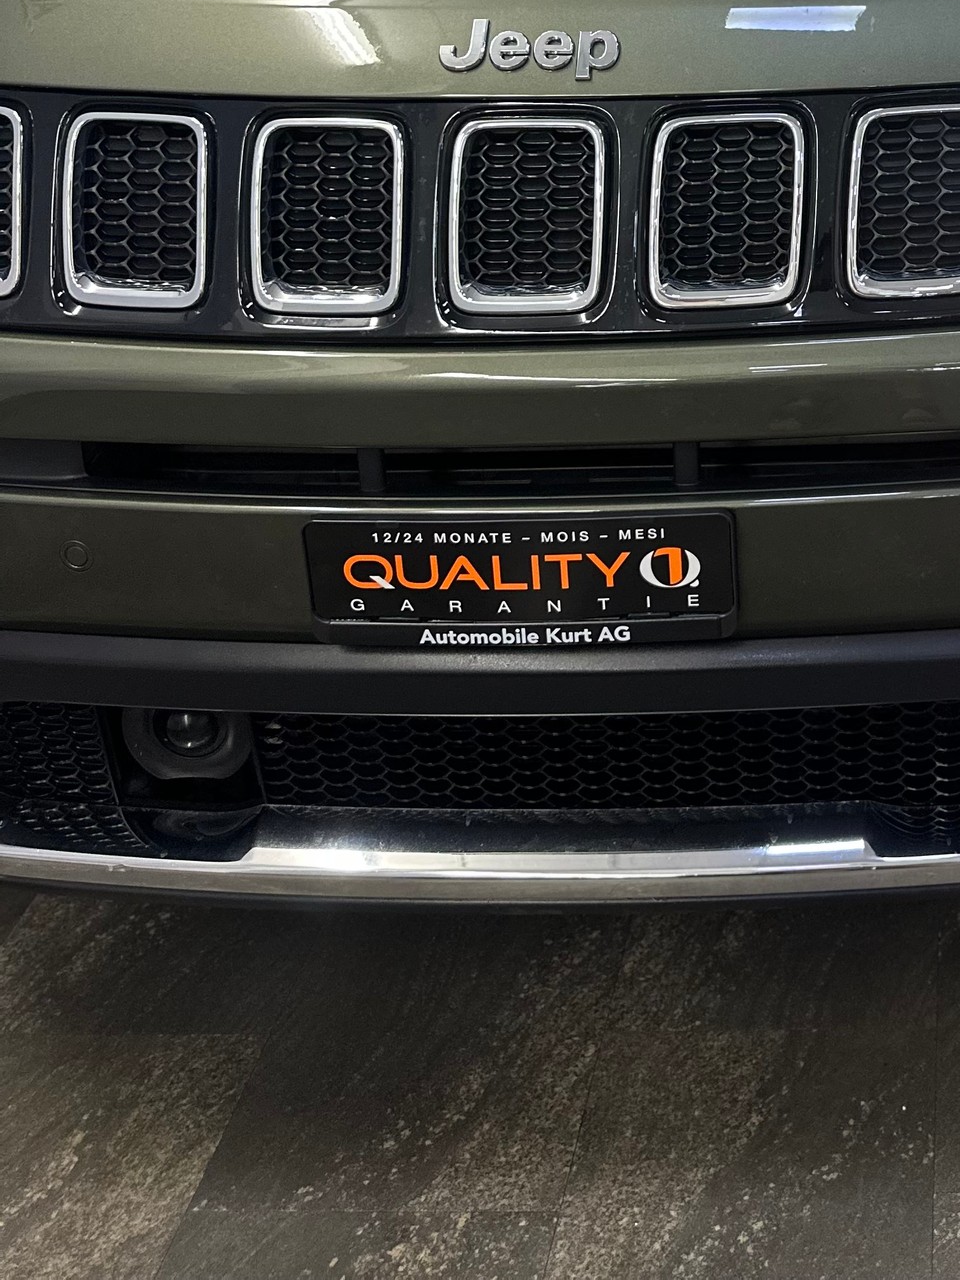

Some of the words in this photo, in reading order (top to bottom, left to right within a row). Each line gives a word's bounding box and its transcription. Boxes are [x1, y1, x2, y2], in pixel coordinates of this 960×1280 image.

[438, 18, 621, 82] Jeep
[371, 532, 424, 544] 12/24
[434, 532, 512, 544] MONATE
[540, 530, 590, 543] MOIS
[618, 527, 665, 541] MESI
[343, 551, 631, 591] QUALITY
[350, 594, 700, 614] GARANTIE
[419, 627, 540, 646] Automobile
[545, 626, 592, 644] Kurt
[597, 625, 631, 643] AG
